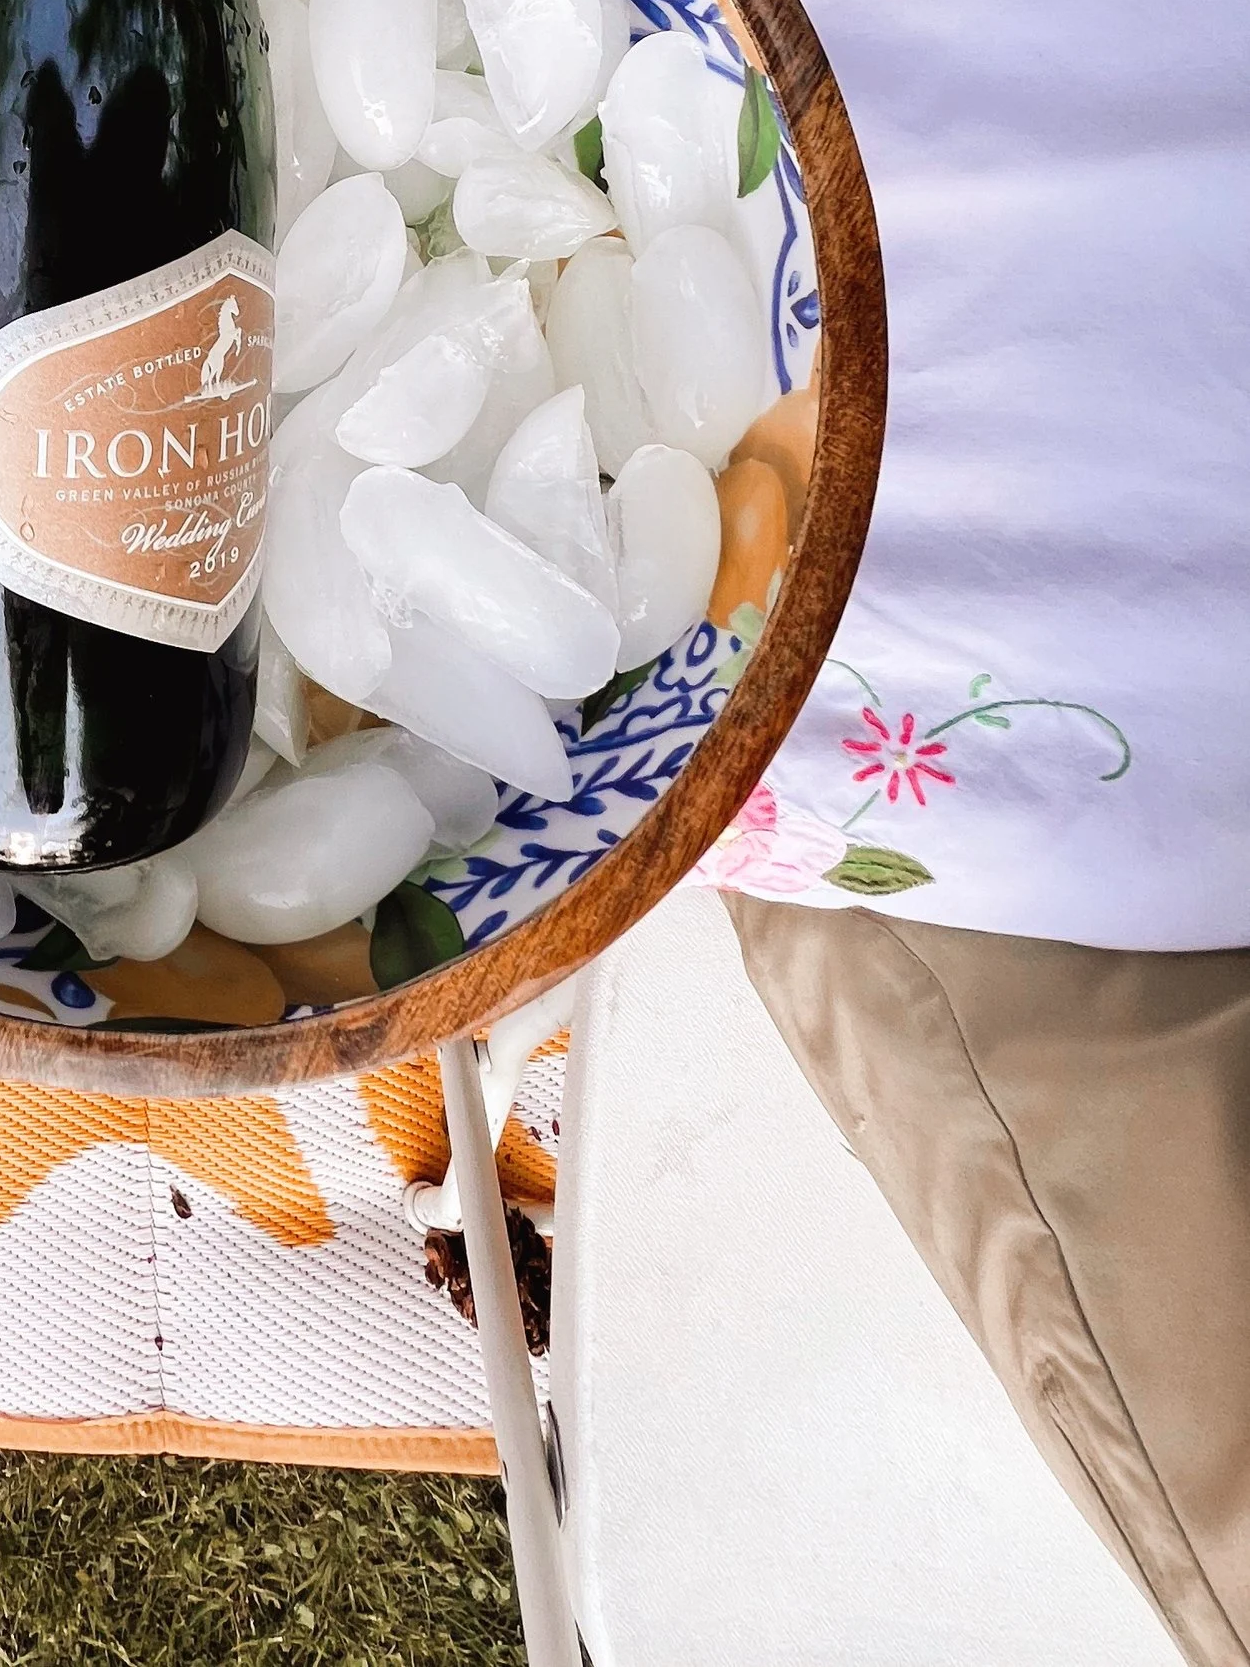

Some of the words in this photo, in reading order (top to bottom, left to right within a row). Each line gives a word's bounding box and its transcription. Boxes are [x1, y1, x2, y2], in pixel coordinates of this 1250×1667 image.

[64, 372, 126, 413] ESTATE
[133, 346, 202, 380] BOTTLED
[32, 422, 199, 479] IRON
[55, 484, 114, 502] GREEN
[122, 482, 179, 501] VALLEY
[186, 479, 201, 492] OF
[206, 461, 250, 487] RUSSIAN
[165, 491, 219, 512] SONOMA
[121, 510, 232, 558] Wedding
[189, 546, 240, 579] 2019
